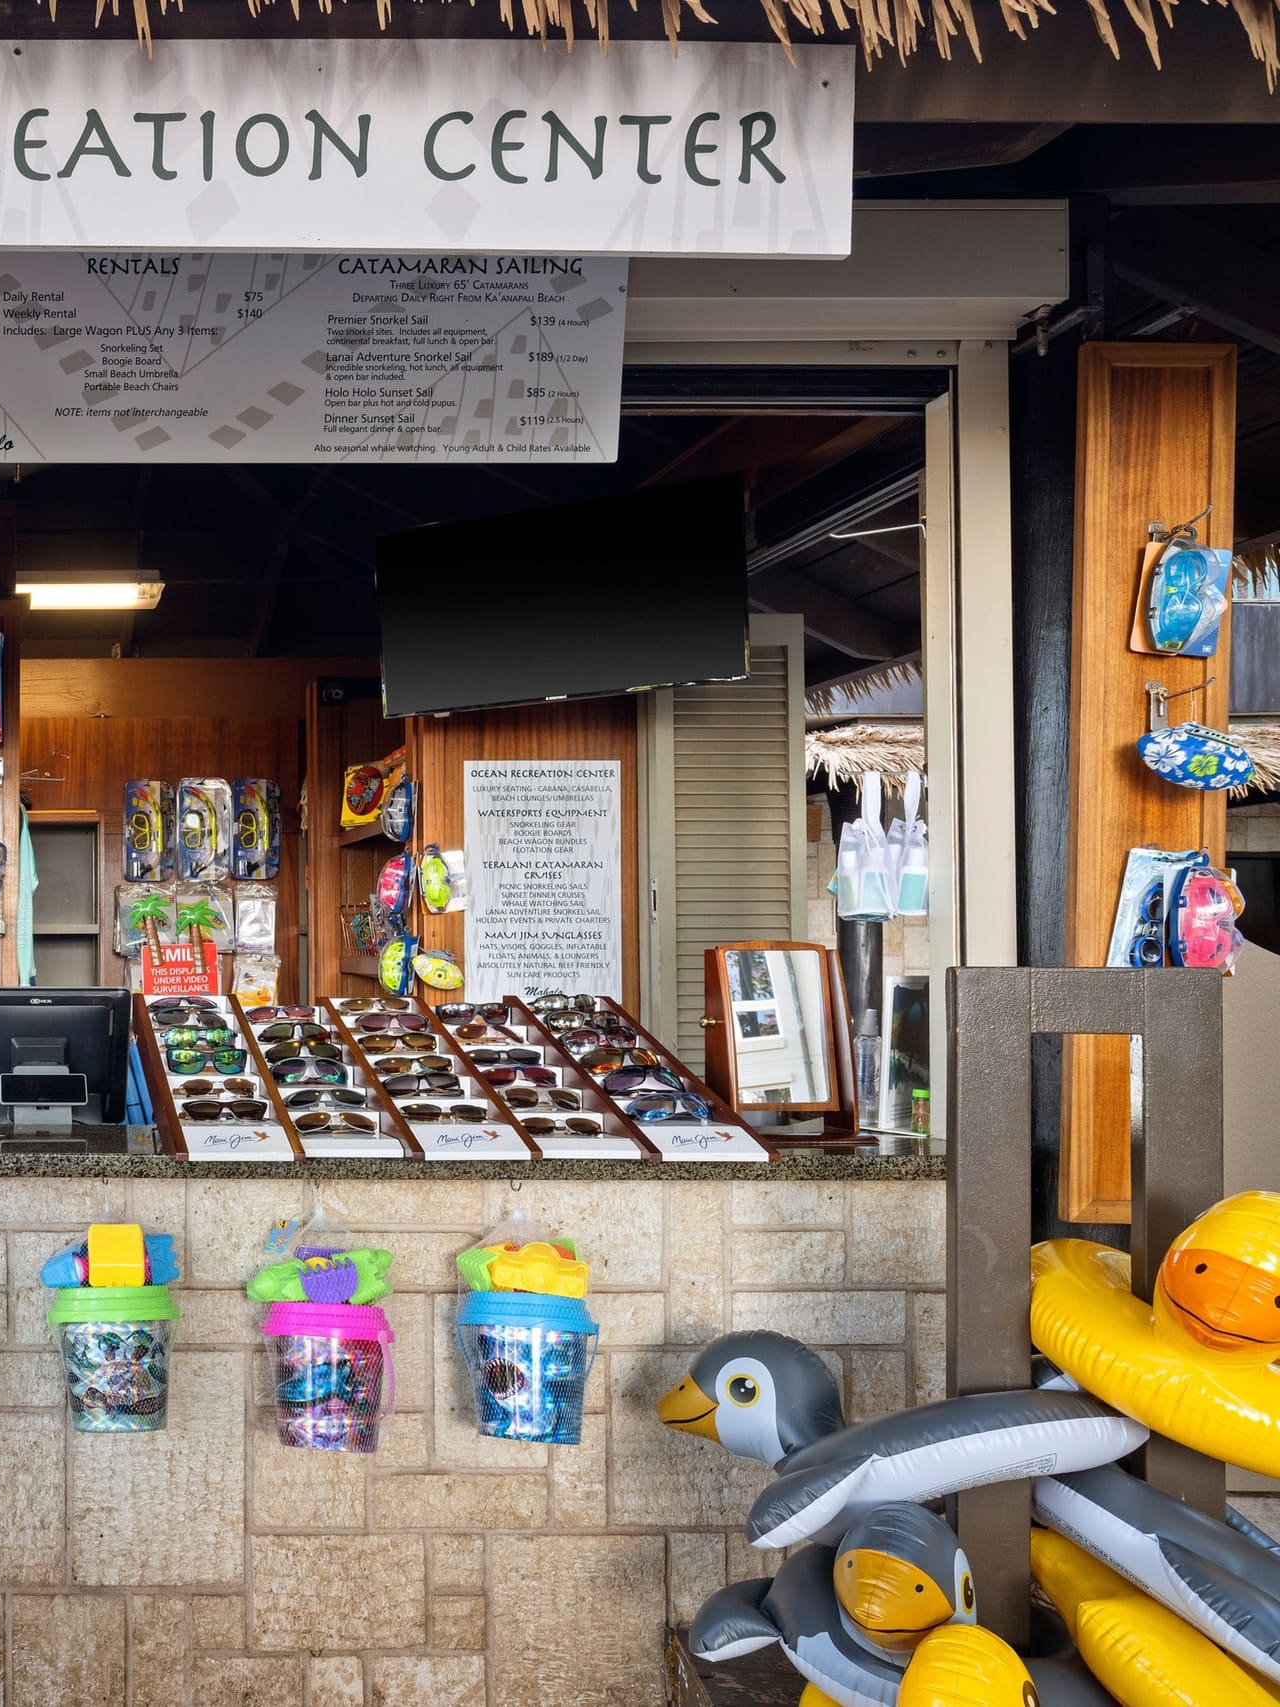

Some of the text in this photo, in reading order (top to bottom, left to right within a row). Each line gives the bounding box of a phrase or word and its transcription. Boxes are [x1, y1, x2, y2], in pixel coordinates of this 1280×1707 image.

[421, 102, 789, 188] CENTER
[87, 258, 181, 275] RENTALS
[338, 257, 583, 276] CATAMARAN SAILING
[3, 290, 263, 304] Daily Rental $75
[3, 308, 263, 320] Weekly Rental $140
[328, 315, 556, 326] Premier Snorkel Sail $139
[3, 325, 47, 335] Includes:
[53, 326, 82, 338] Large
[85, 326, 122, 337] Wagon
[126, 326, 151, 335] PLUS
[154, 326, 174, 337] Any
[187, 326, 218, 336] Items:
[326, 352, 554, 364] Lanai Adventure Snorkel Sail $189
[325, 387, 545, 397] Holo Holo Sunset Sail $85
[55, 408, 84, 416] NOTE:
[87, 408, 111, 416] items
[133, 408, 208, 419] interchangeable
[324, 413, 545, 425] Dinner Sunset Sail $119
[471, 770, 507, 778] OCEAN
[511, 770, 572, 778] RECREATION
[478, 809, 608, 818] WATERSPORTS EQUIPMENT
[483, 861, 603, 869] TERALANI CATAMARAN
[524, 871, 562, 879] CRUISES
[520, 932, 539, 940] JIM
[541, 931, 602, 939] SUNGLASSES
[151, 966, 194, 975] THIS DISPLA
[154, 976, 208, 984] UNDER VIDEO
[152, 984, 209, 994] SURVEILLANCE
